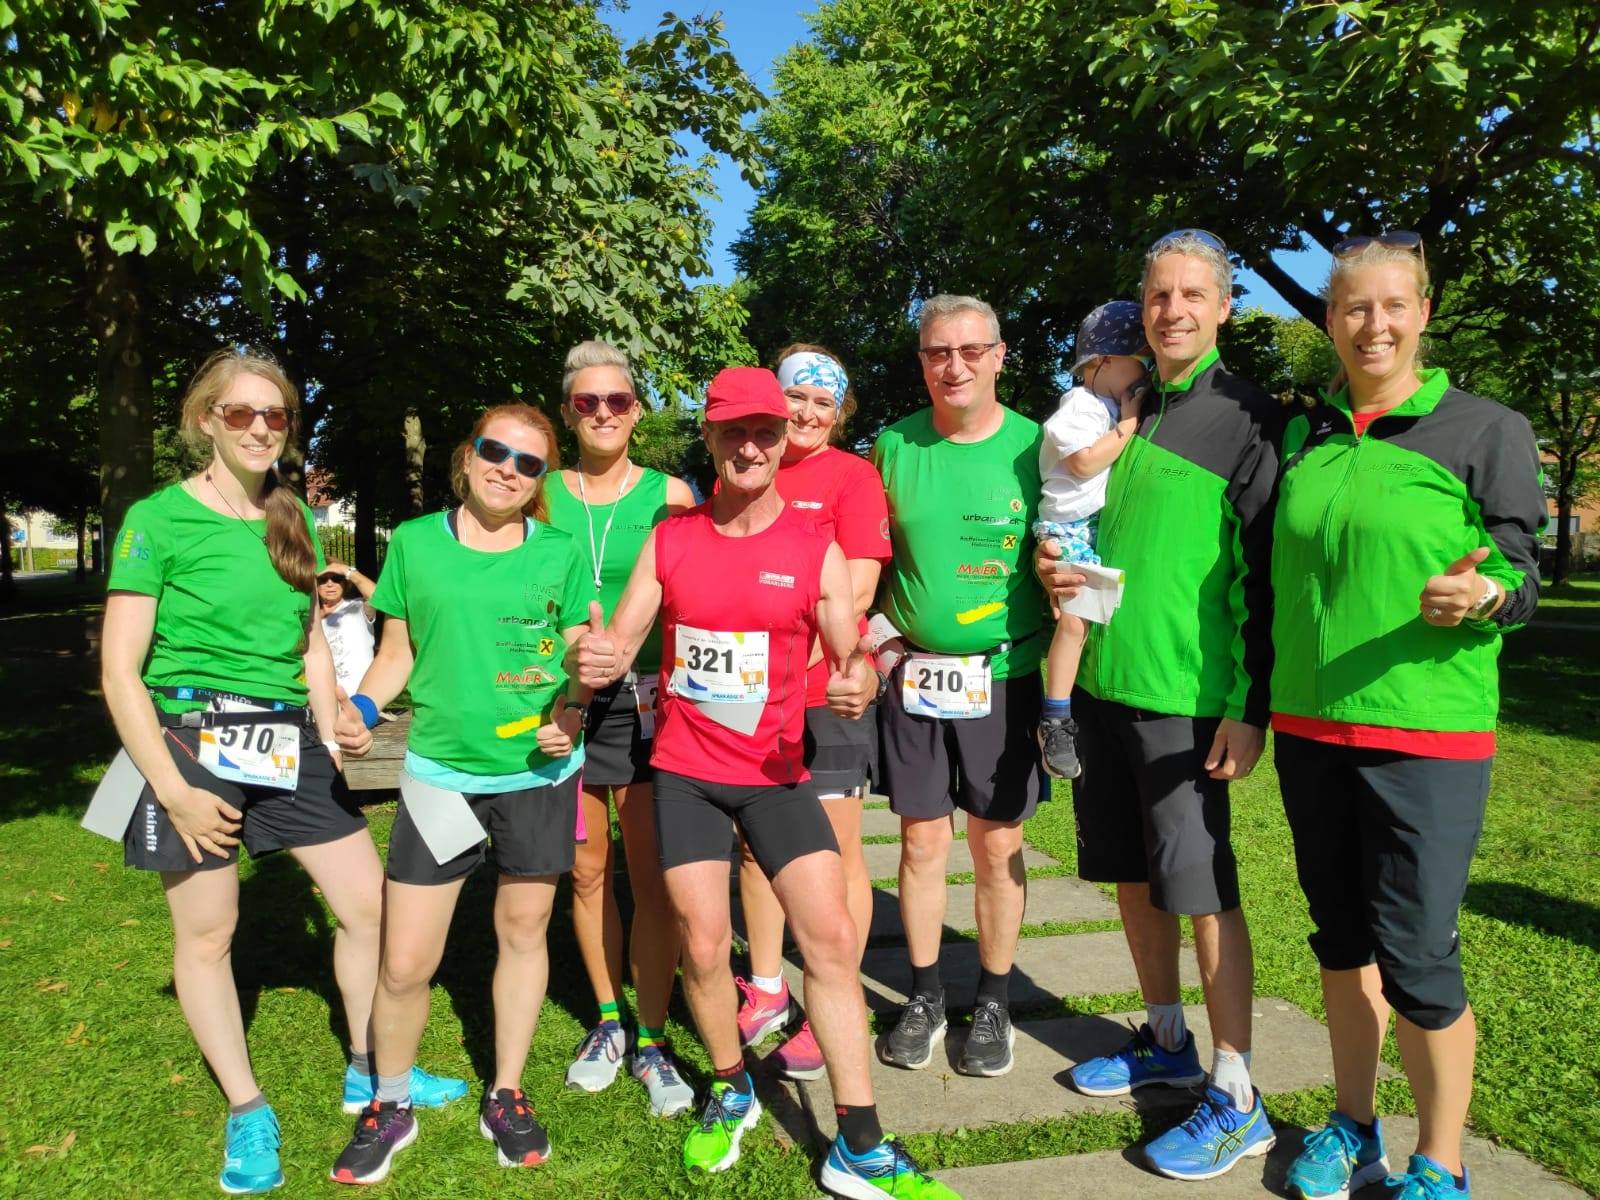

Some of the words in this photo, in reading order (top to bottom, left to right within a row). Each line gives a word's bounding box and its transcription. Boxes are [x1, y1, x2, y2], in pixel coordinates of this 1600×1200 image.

[687, 644, 734, 674] 321
[918, 667, 964, 693] 210
[219, 722, 275, 755] 510
[146, 803, 158, 852] skinfit
